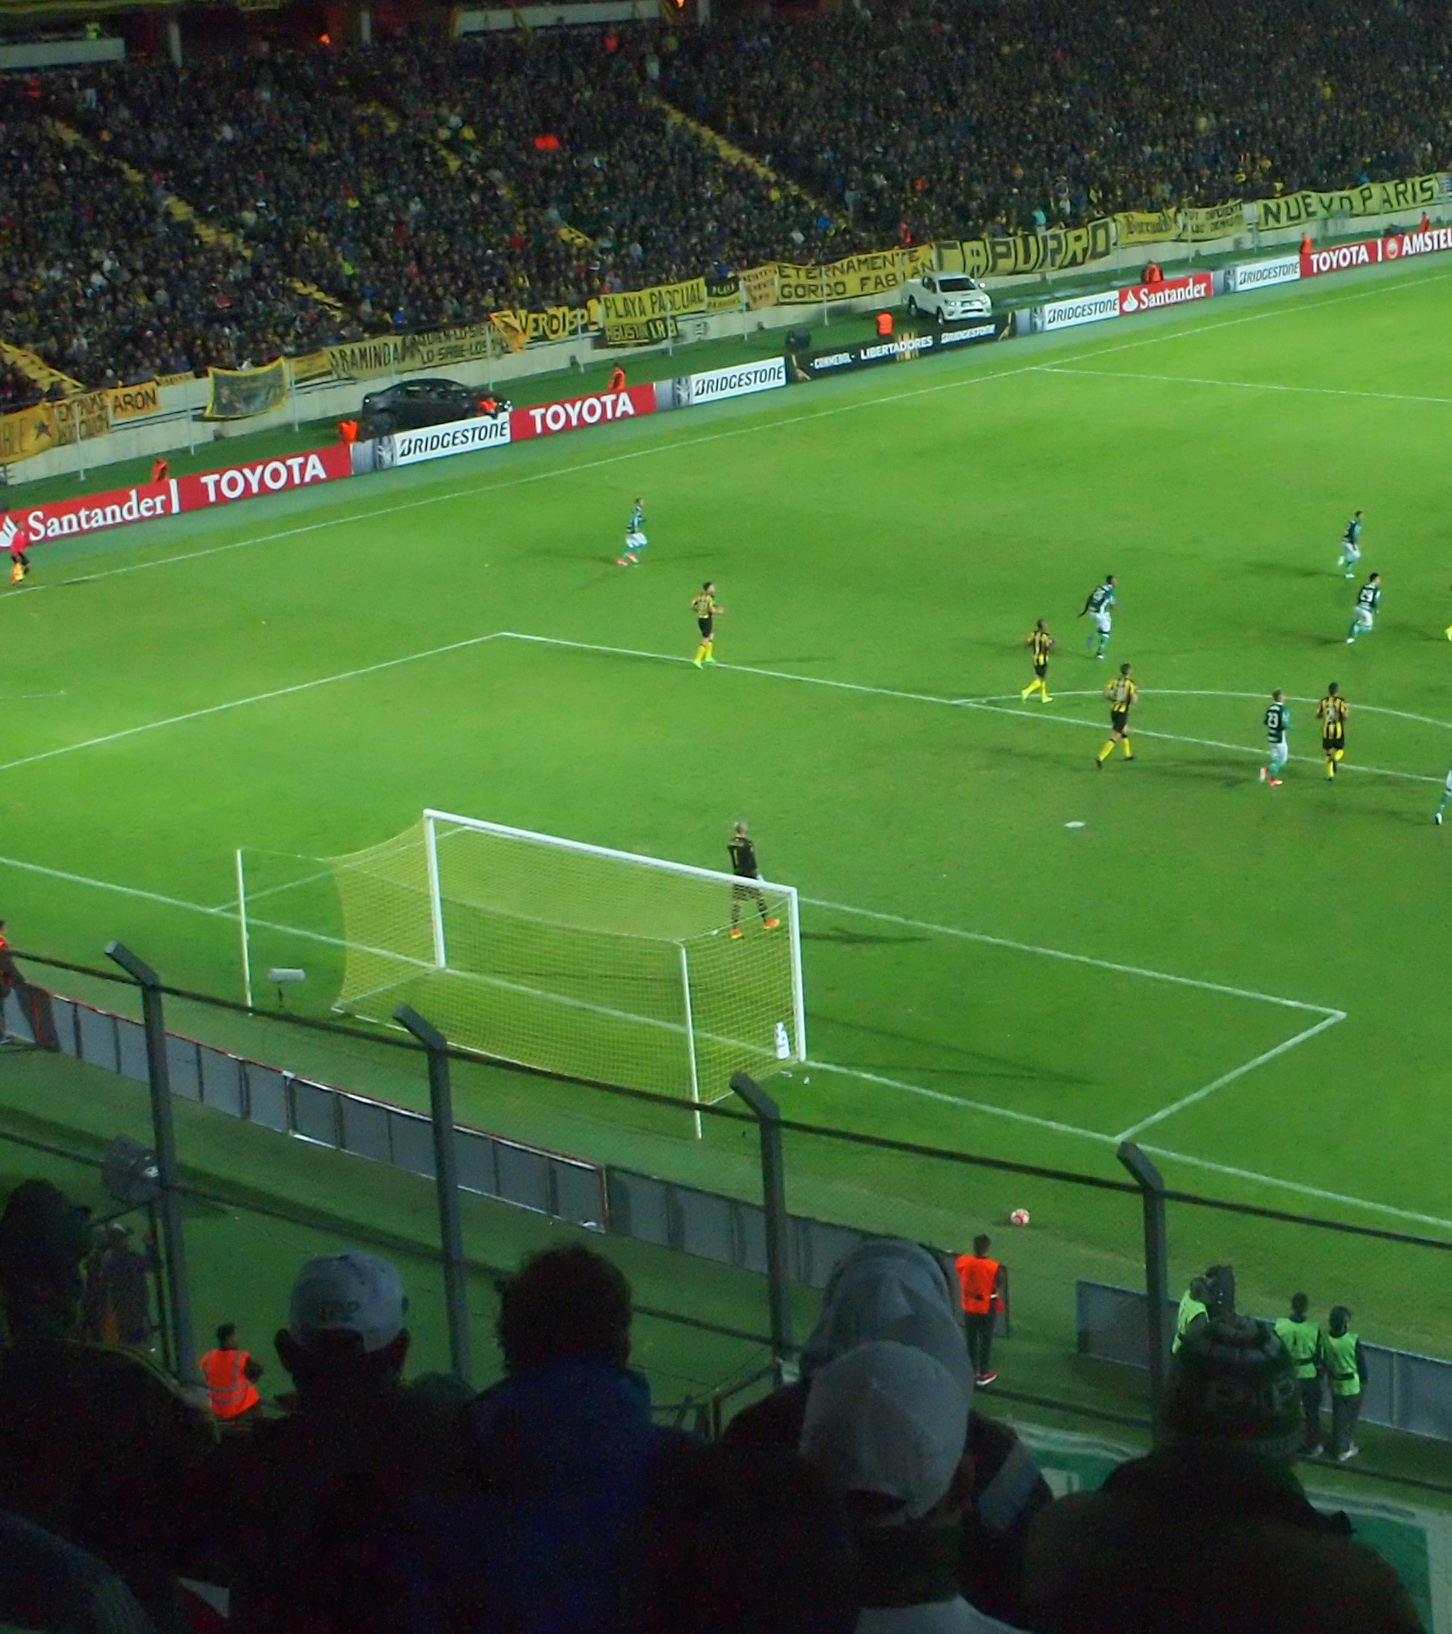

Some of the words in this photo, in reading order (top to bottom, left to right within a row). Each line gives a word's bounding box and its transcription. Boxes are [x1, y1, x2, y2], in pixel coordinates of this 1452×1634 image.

[1264, 190, 1354, 221] NUEVO
[1361, 179, 1435, 210] PARIS
[778, 251, 920, 280] ETERNAMENTE
[1238, 262, 1300, 286] BRIDGESTONE
[1310, 244, 1370, 273] TOYOTA
[603, 296, 646, 319] PLAYA
[650, 281, 702, 314] PASCUAL
[780, 279, 847, 300] GORDO
[1139, 278, 1207, 309] Santander
[1047, 299, 1119, 324] BRIDGESTONE
[861, 336, 933, 360] LIBERTADORES
[695, 365, 785, 398] BRIDGESTONE
[530, 392, 635, 434] TOYOTA
[399, 420, 508, 458] BRIDGESTONE
[201, 454, 327, 502] TOYOTA
[28, 488, 166, 541] Santander
